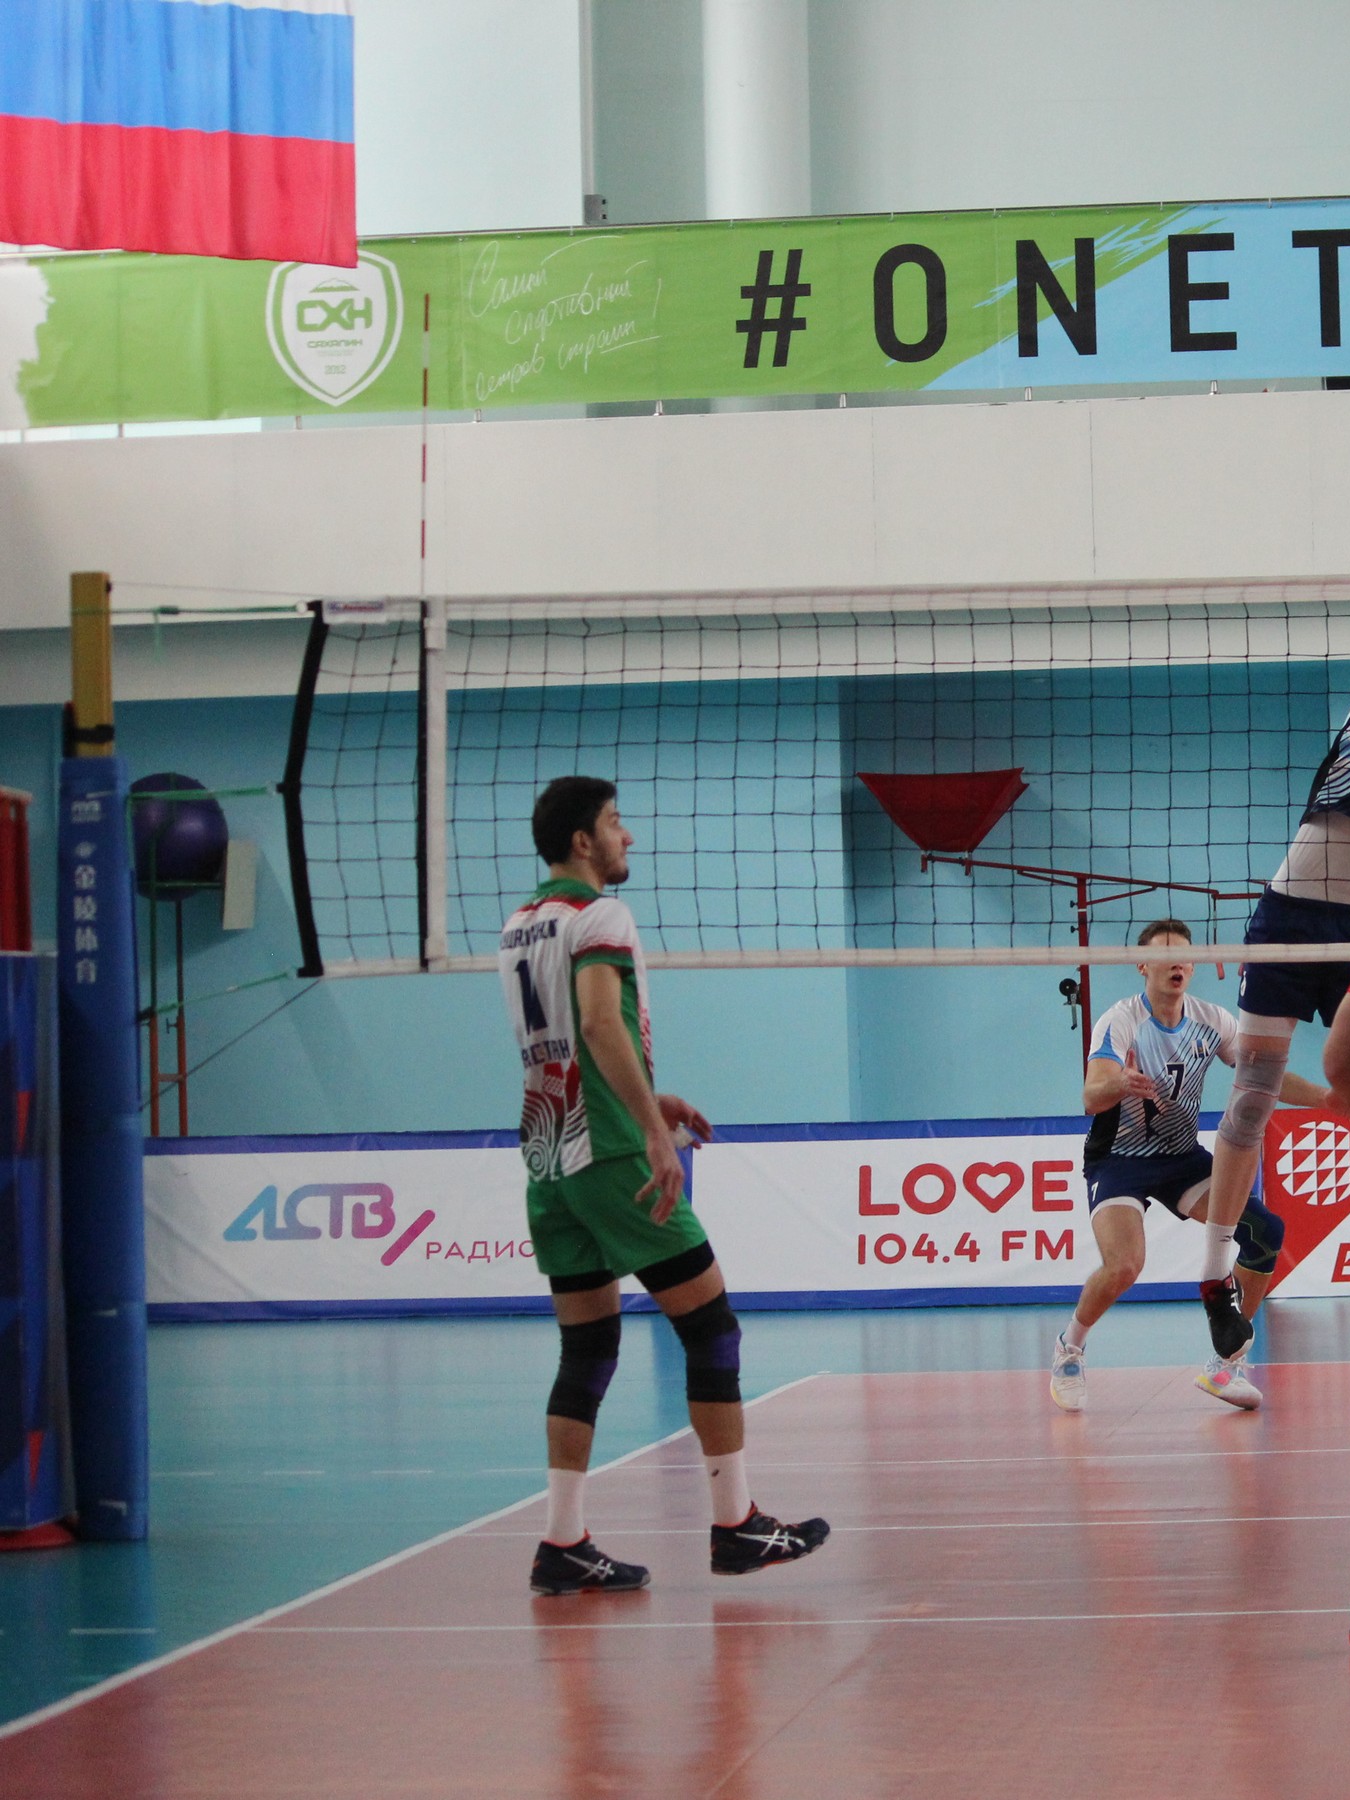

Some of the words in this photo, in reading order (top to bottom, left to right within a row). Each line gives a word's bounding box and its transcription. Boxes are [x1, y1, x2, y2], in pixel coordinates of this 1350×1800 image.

[514, 959, 548, 1036] 1
[1165, 1061, 1186, 1101] 7
[426, 1240, 536, 1264] РАДИО
[857, 1231, 981, 1265] 104.4
[1001, 1229, 1074, 1261] FM
